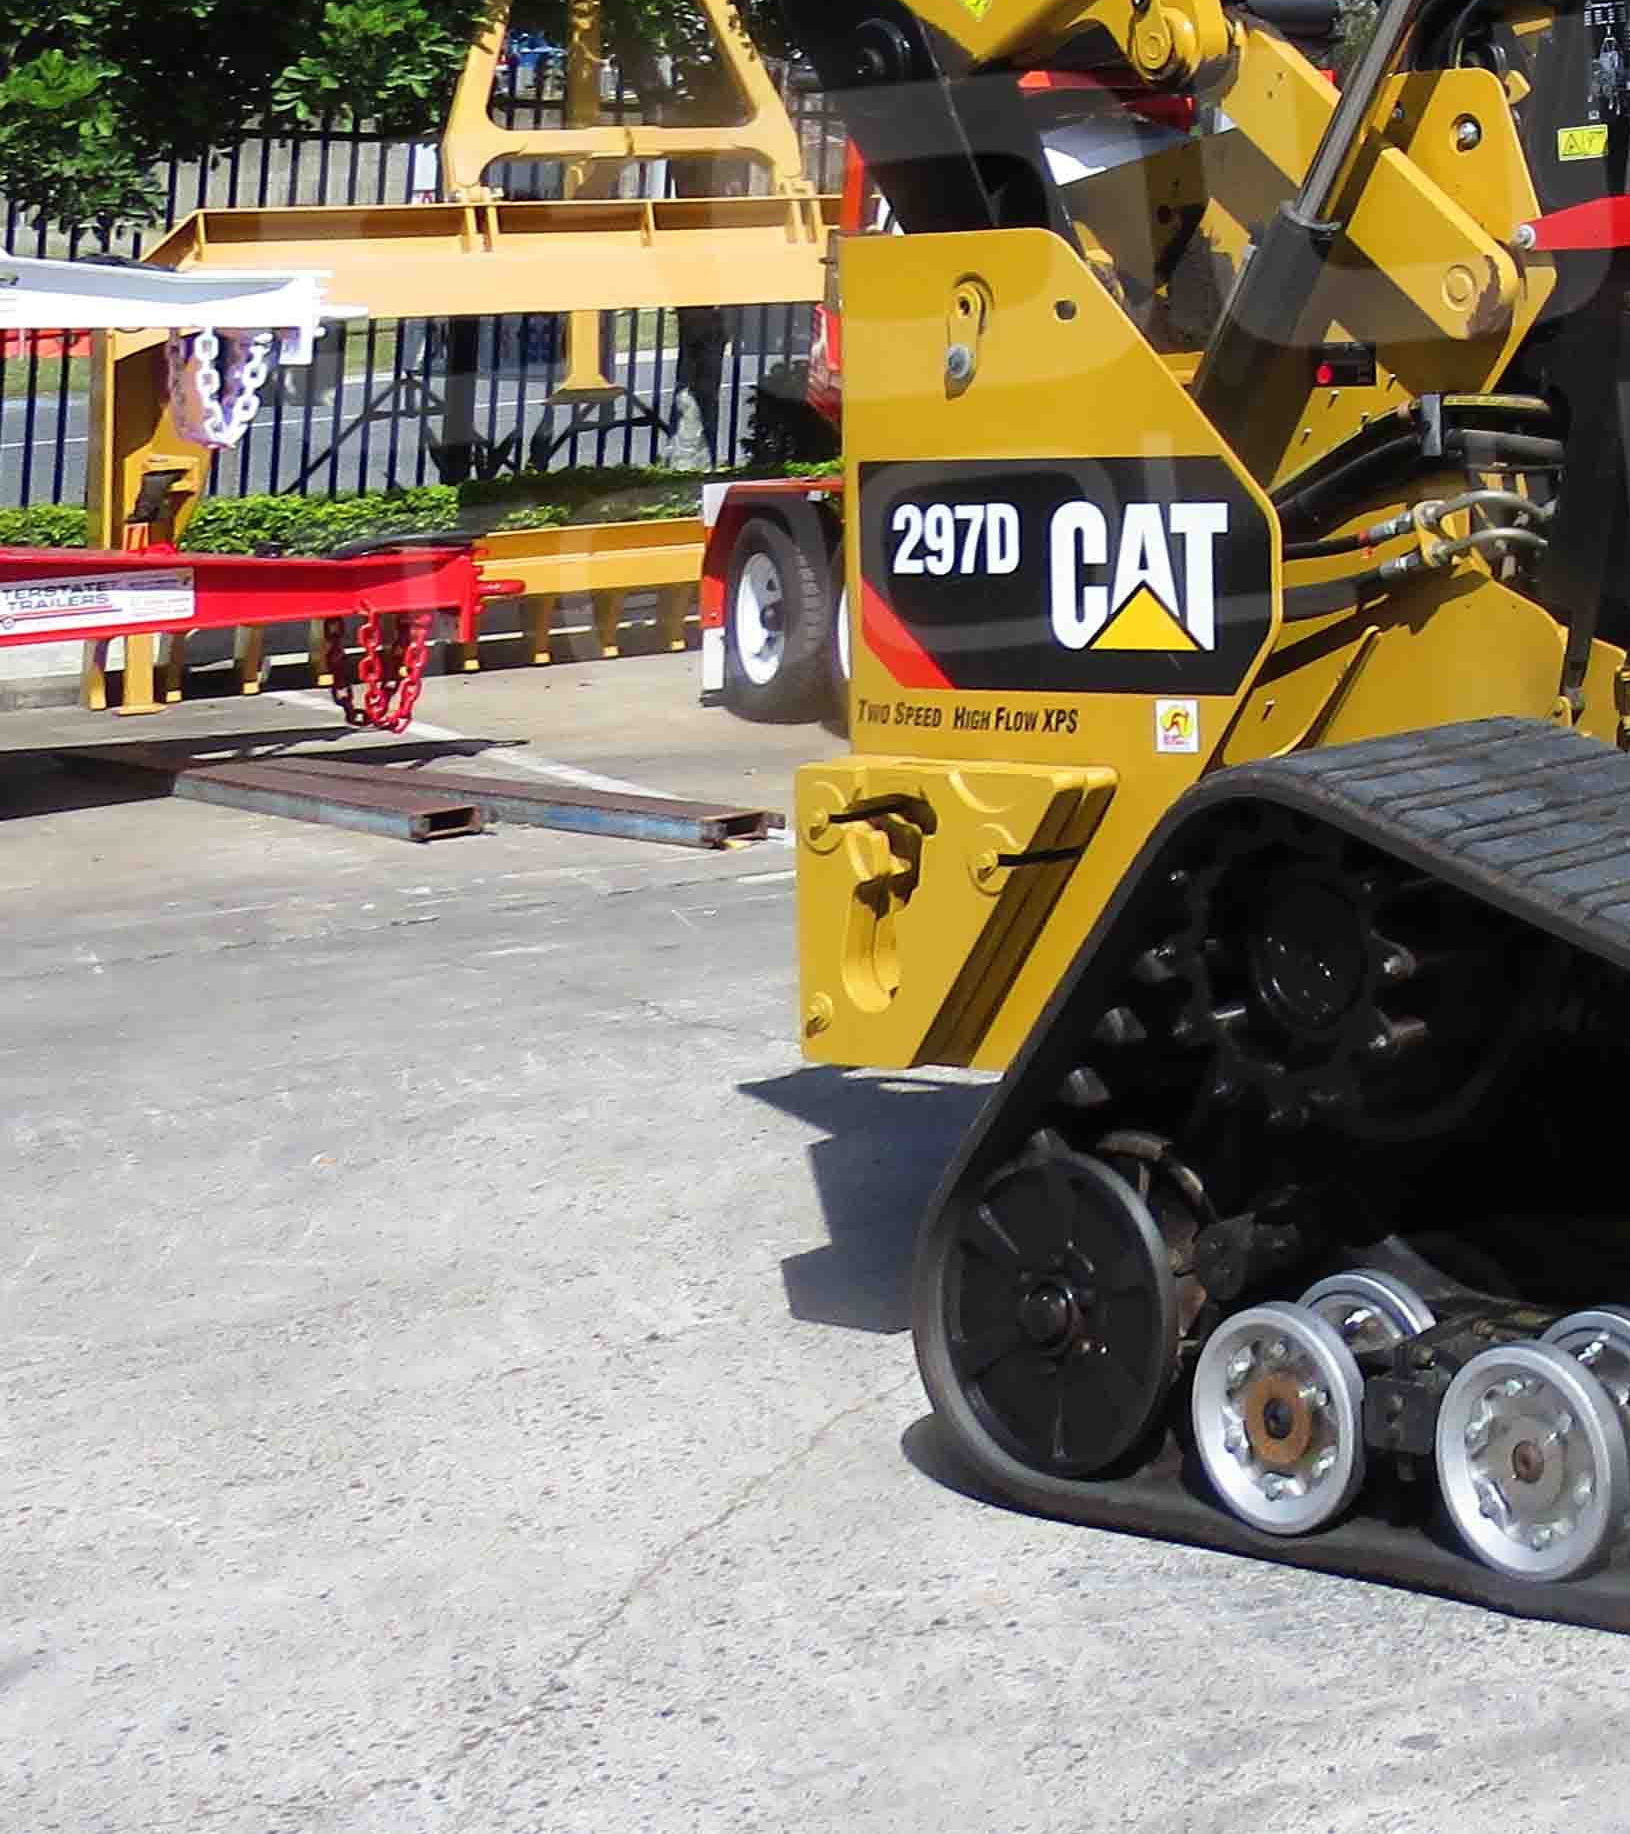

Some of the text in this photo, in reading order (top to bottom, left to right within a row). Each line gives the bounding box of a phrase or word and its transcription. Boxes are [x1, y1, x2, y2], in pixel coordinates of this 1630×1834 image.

[892, 501, 1229, 652] 297D CAT
[8, 594, 111, 612] TRAILERS
[857, 699, 1080, 734] TWO SPEED HIGH FLOW XPS
